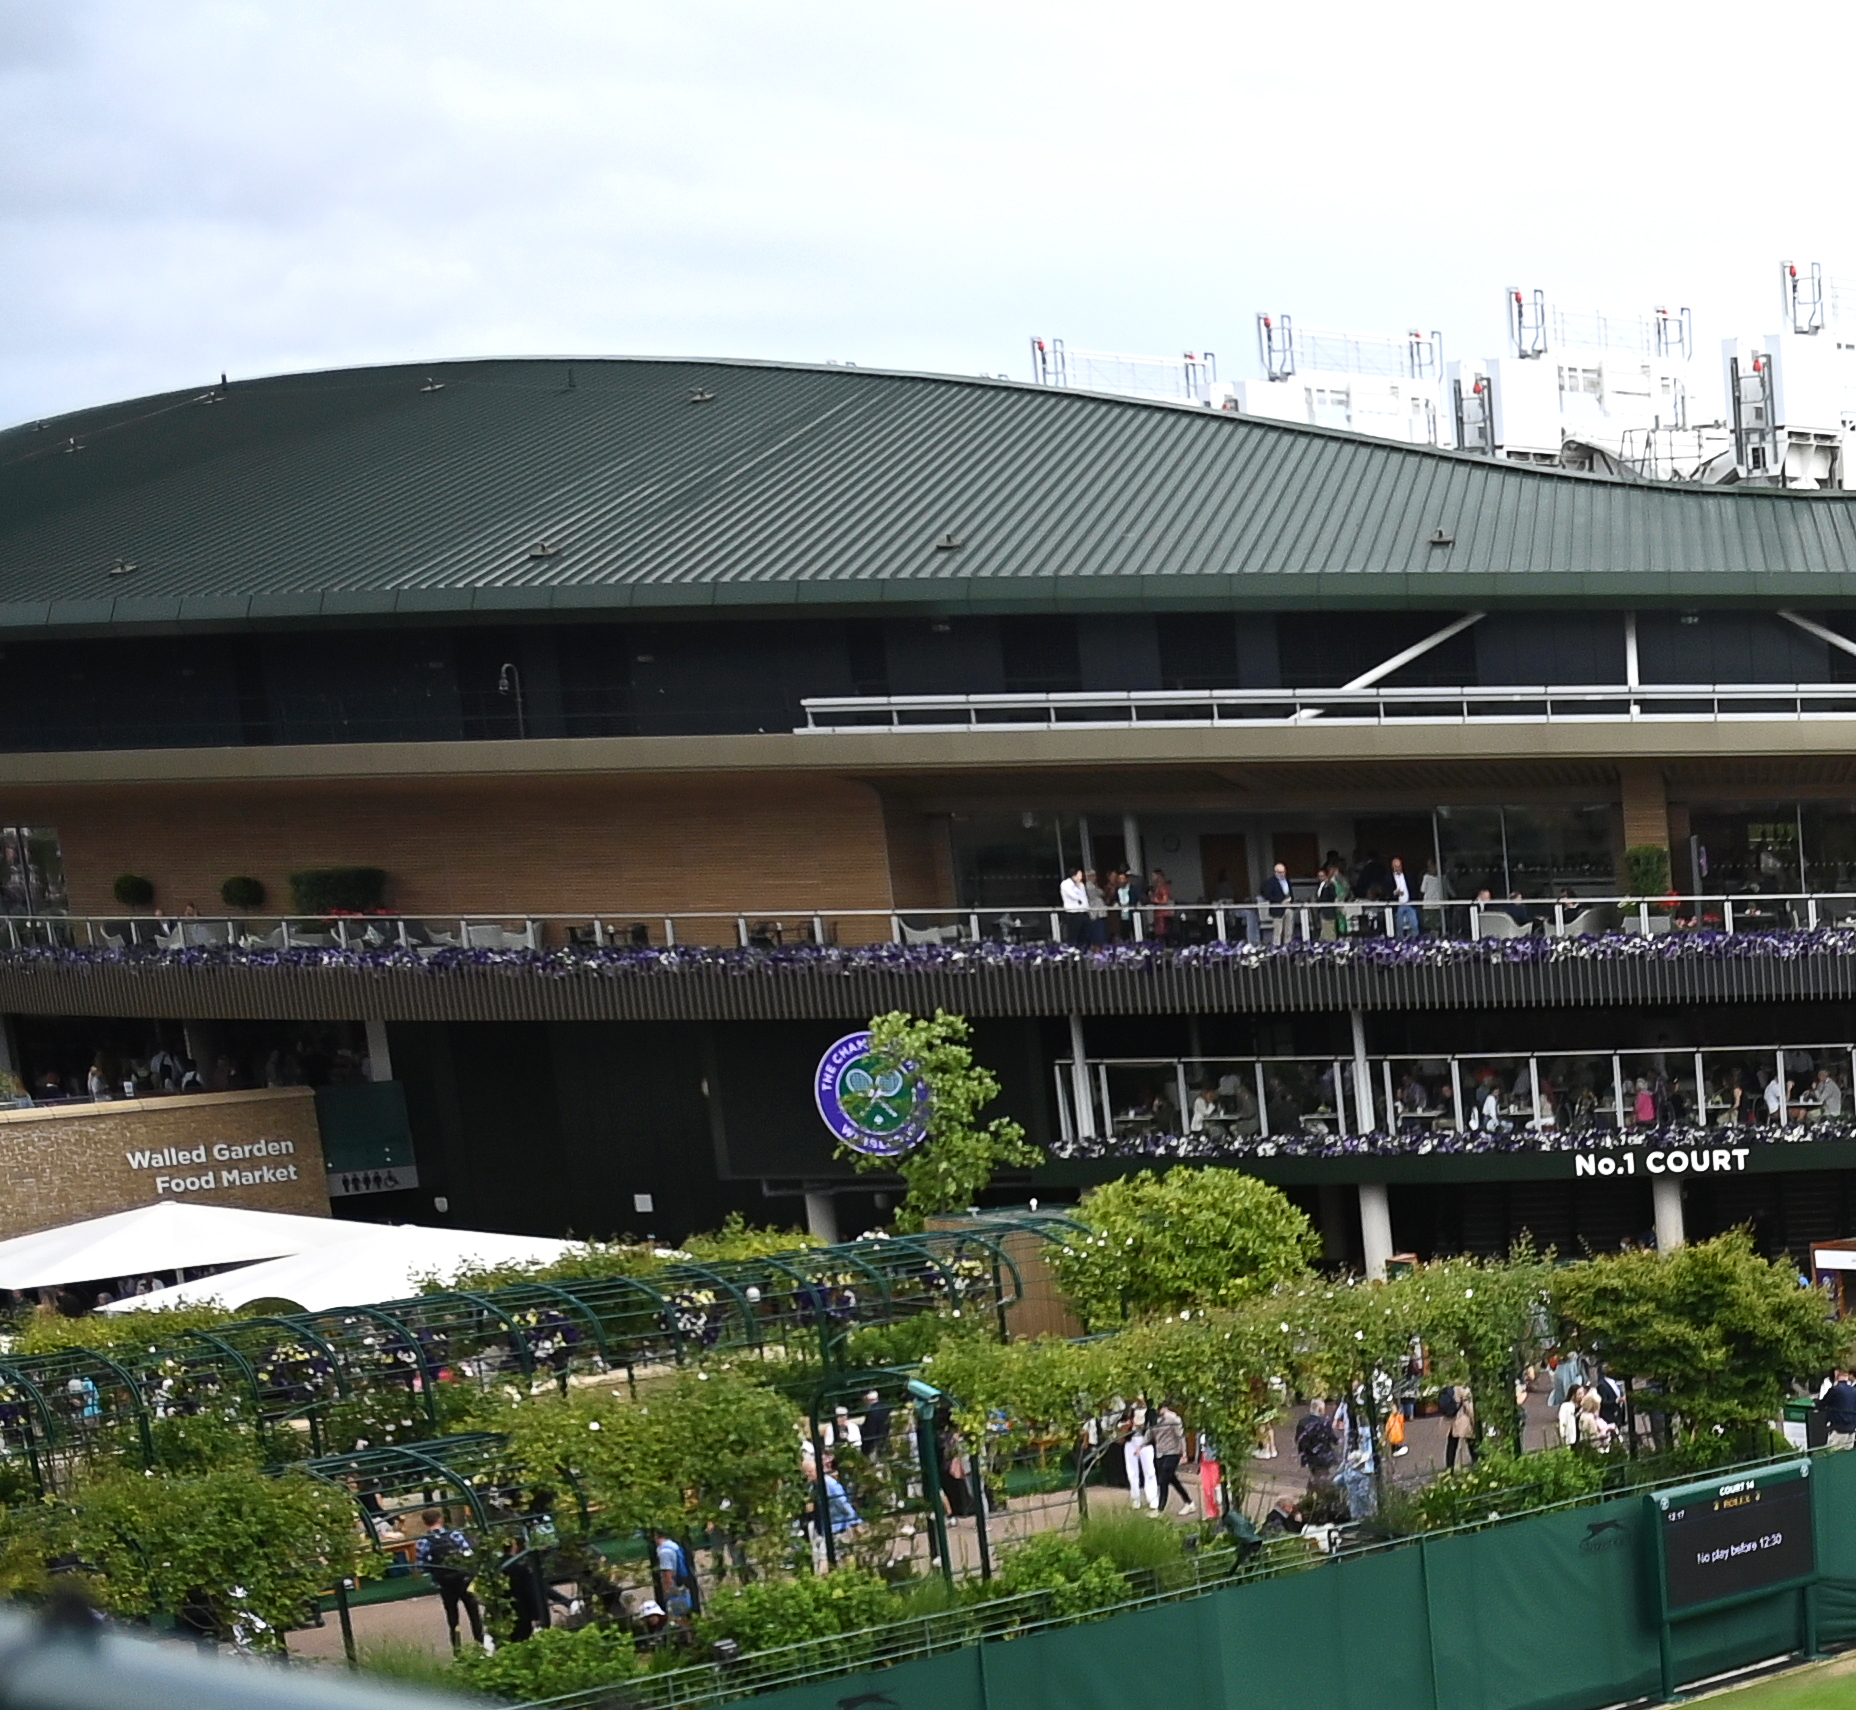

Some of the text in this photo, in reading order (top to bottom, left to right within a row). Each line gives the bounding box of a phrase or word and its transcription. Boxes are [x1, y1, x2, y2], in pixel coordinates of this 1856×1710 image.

[822, 1064, 837, 1091] THE
[126, 1138, 294, 1170] Walled Garden
[1575, 1148, 1750, 1177] No.1 COURT
[156, 1163, 298, 1194] Food Market
[1719, 1482, 1745, 1497] COURT
[1697, 1551, 1710, 1564] No
[1712, 1548, 1729, 1563] play
[1730, 1541, 1757, 1556] before
